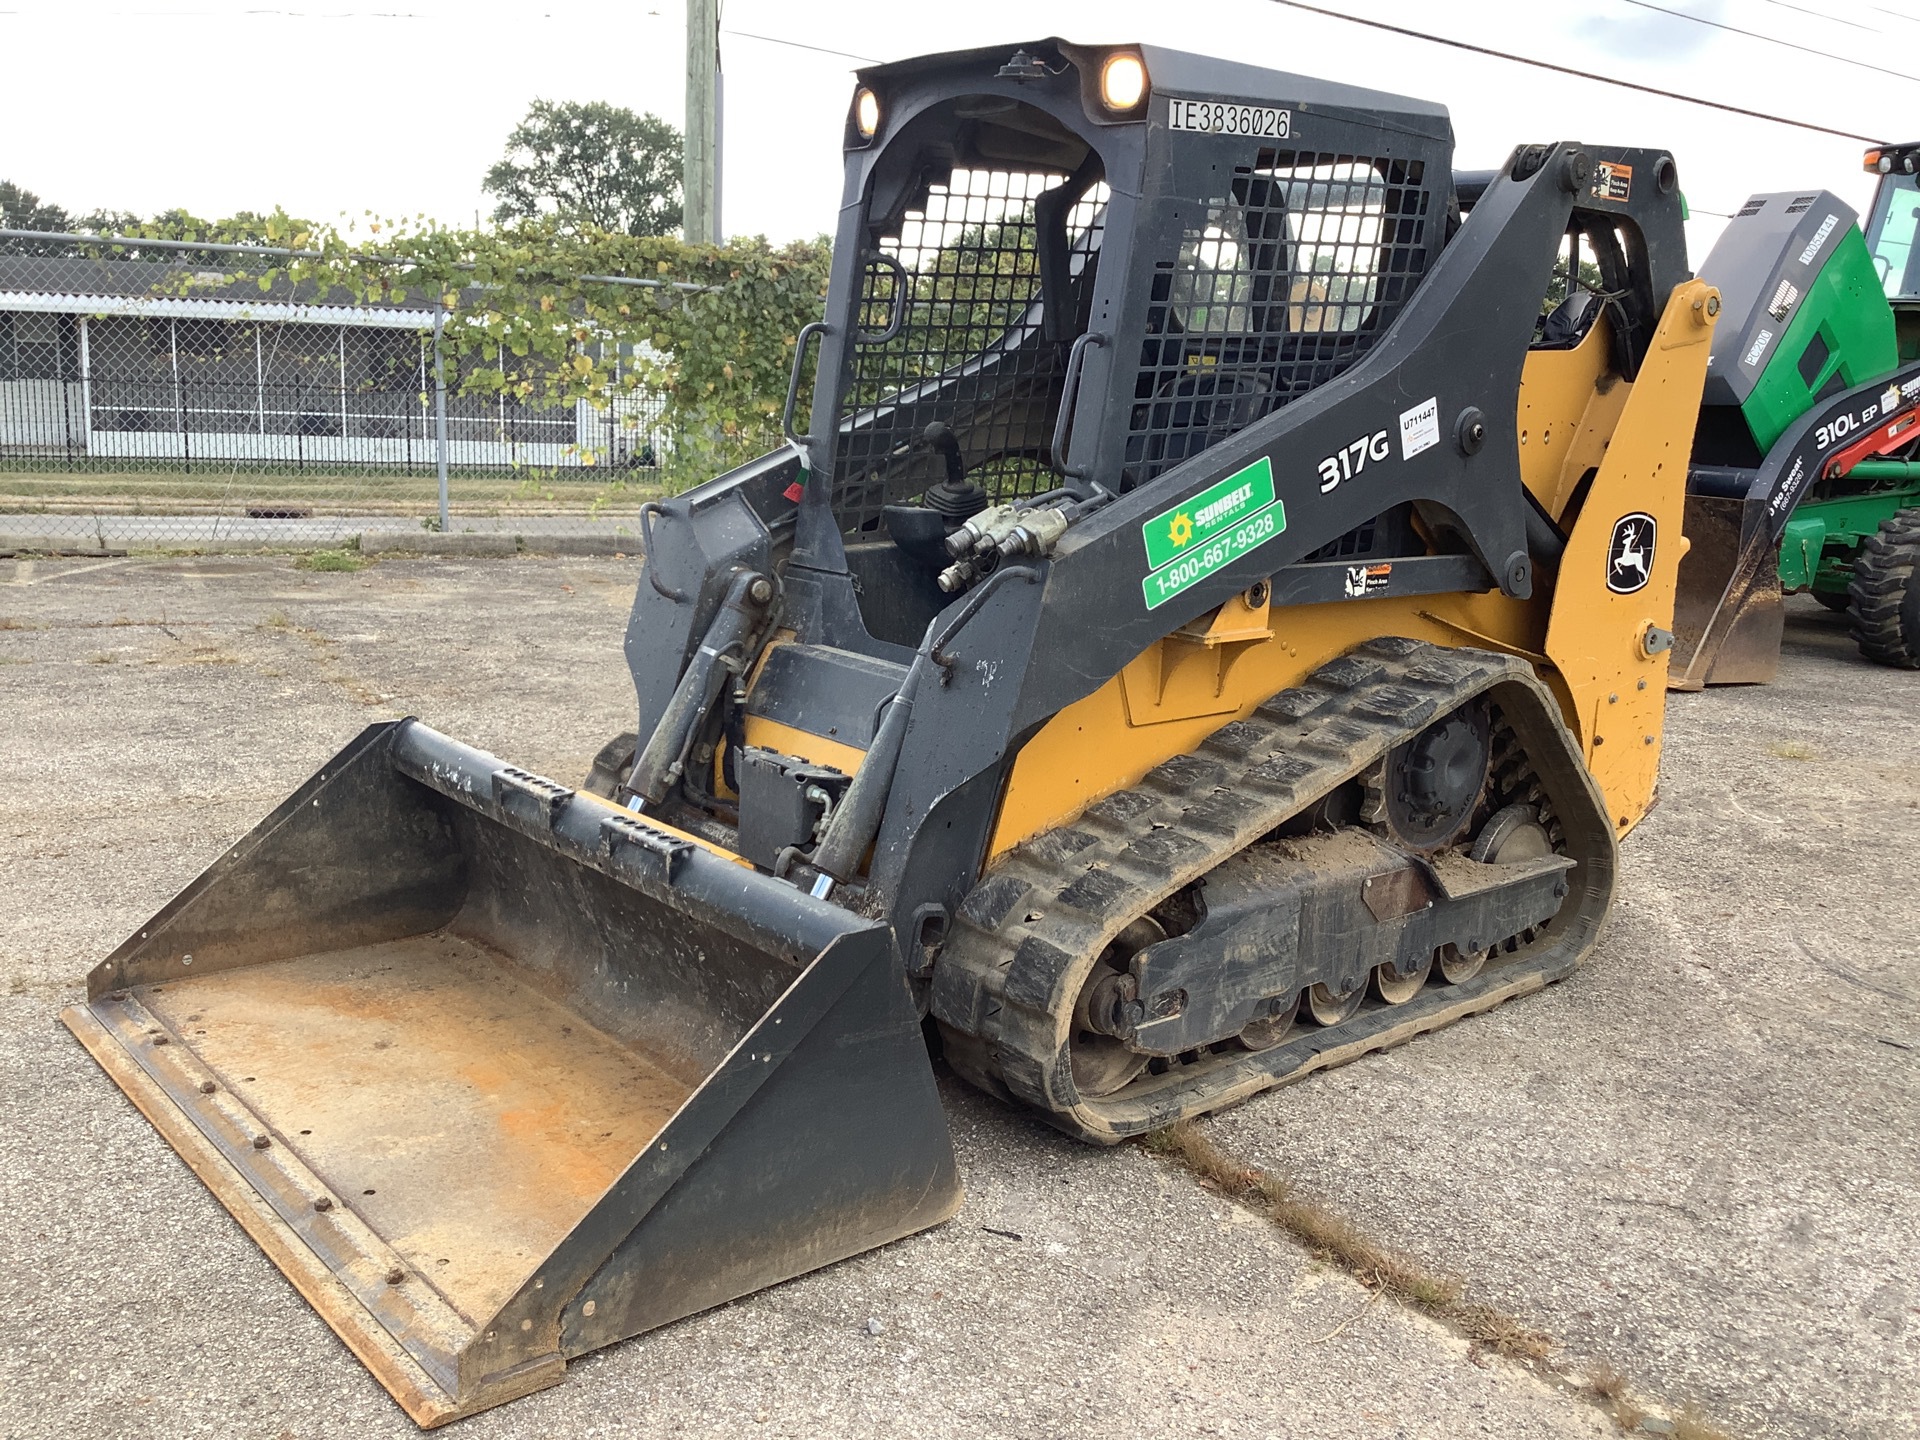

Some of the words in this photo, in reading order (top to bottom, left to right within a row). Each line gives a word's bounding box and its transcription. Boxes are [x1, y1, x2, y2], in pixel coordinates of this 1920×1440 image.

[1801, 216, 1837, 262] 10054141
[1746, 330, 1771, 365] PC200
[1403, 406, 1435, 430] U711447
[1815, 413, 1860, 450] 310L
[1862, 404, 1878, 423] EP
[1317, 429, 1390, 494] 317G
[1772, 491, 1784, 509] No
[1781, 458, 1803, 492] Sweat
[1194, 482, 1252, 527] SUNBELT
[1205, 501, 1246, 530] RENTALS
[1156, 513, 1274, 595] 1-800-667-9328
